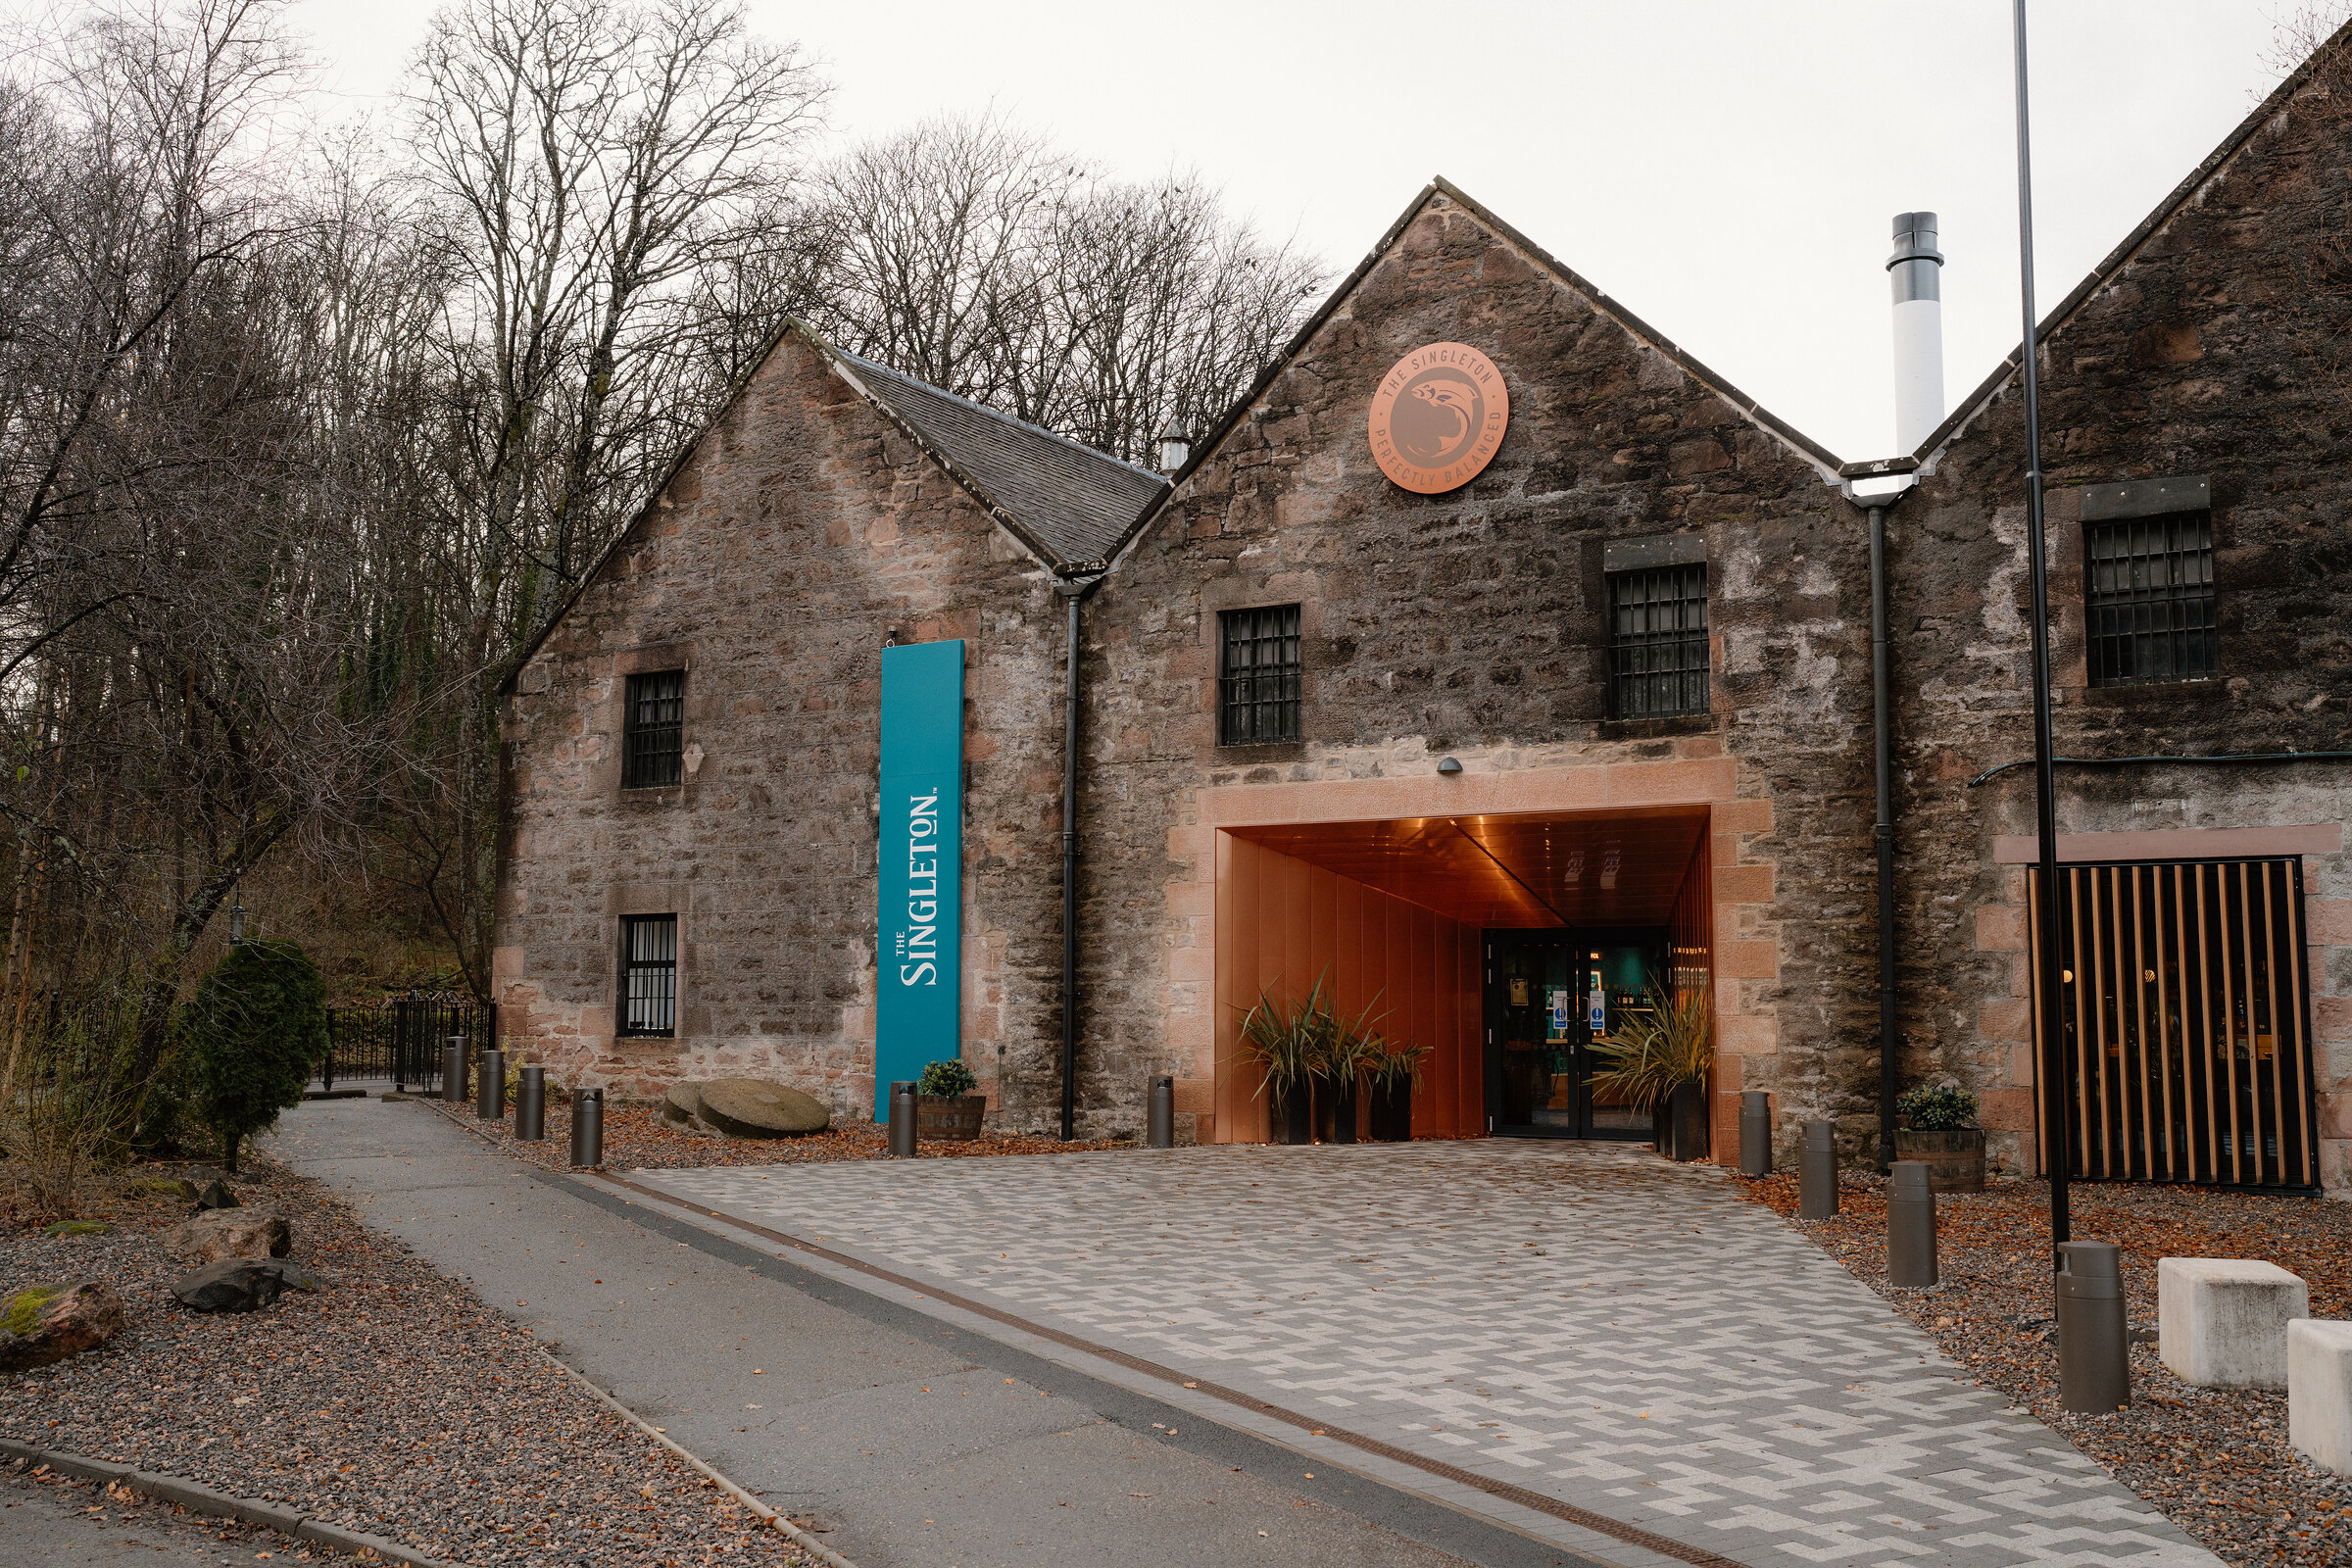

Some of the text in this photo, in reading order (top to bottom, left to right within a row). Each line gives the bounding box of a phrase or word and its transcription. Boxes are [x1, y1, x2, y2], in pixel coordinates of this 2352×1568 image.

[1383, 350, 1493, 398] THE SINGLETON
[1375, 412, 1501, 487] PERFECTLY BALANCED
[900, 795, 938, 987] SINGLETON
[896, 931, 906, 957] THE
